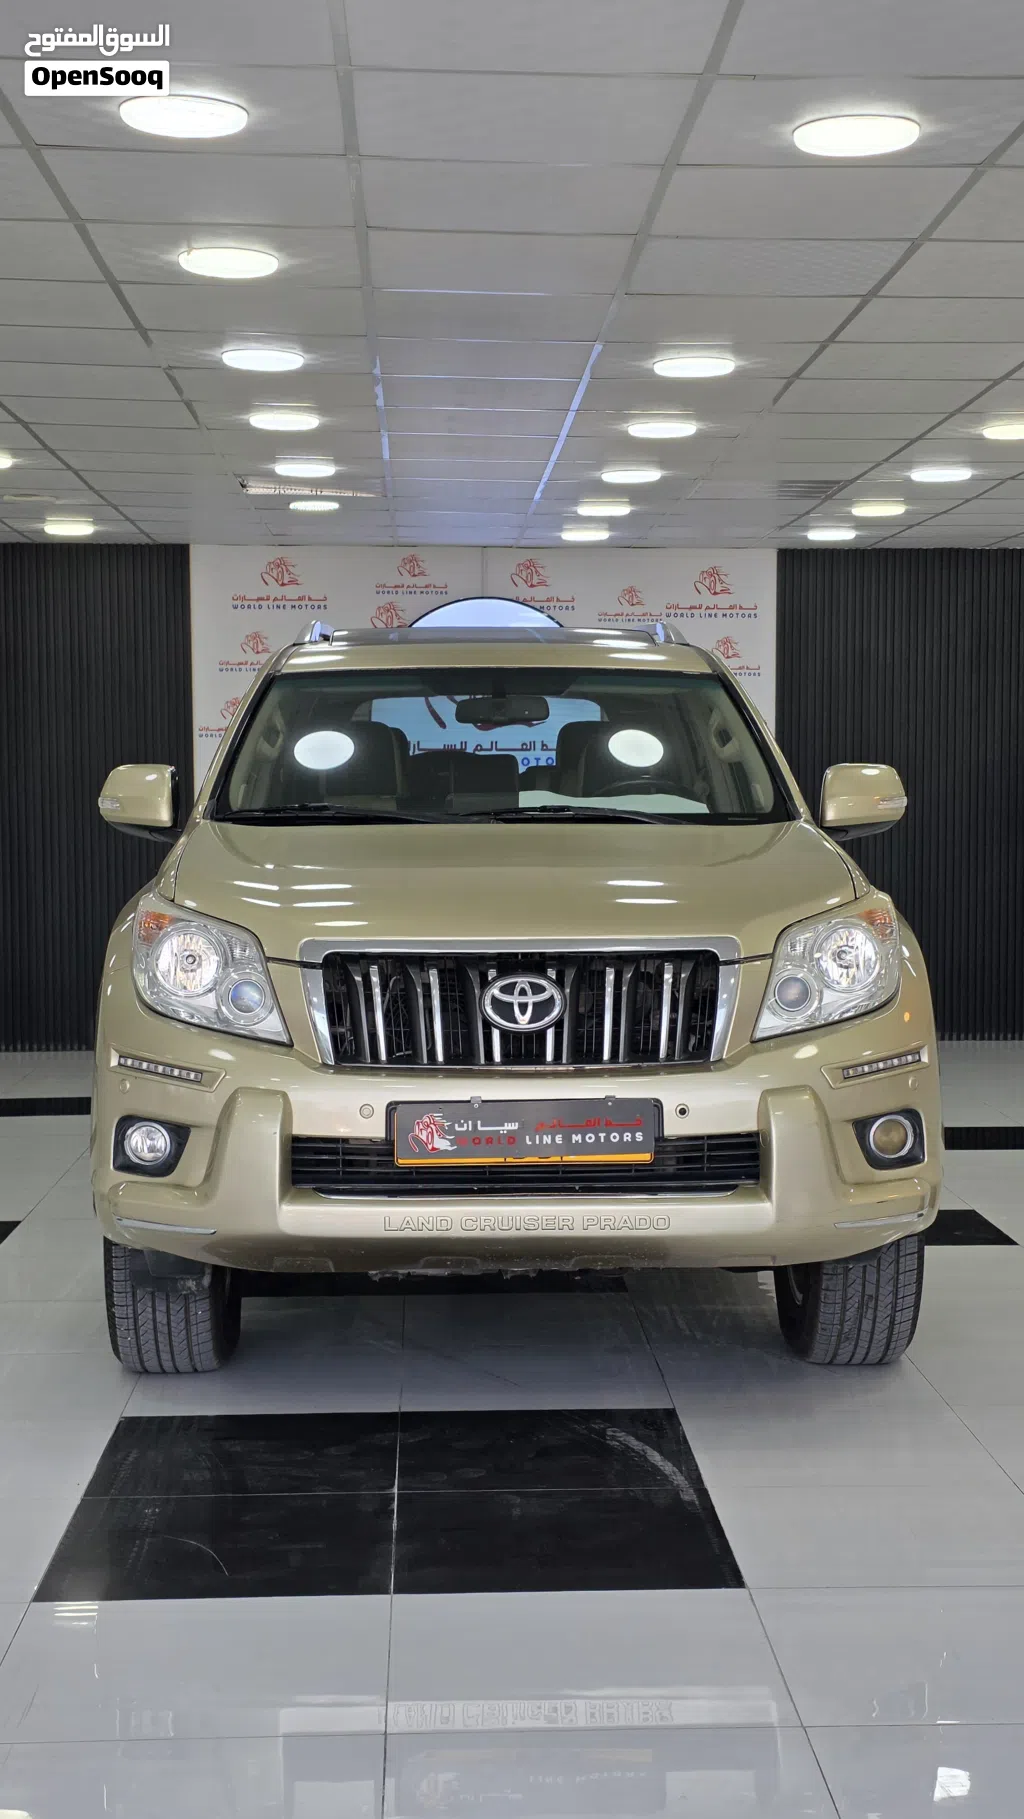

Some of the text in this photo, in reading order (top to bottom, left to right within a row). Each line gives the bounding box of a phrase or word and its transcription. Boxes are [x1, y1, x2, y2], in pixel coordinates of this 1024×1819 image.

[231, 593, 327, 603] خط العالم للسيارات
[665, 602, 758, 611] خط العالم للسيارات
[473, 740, 536, 754] العالم
[535, 1117, 600, 1132] العالم
[525, 1134, 563, 1145] LINE
[572, 1132, 644, 1144] MOTORS
[383, 1215, 671, 1231] LAND CRUISER PRADO
